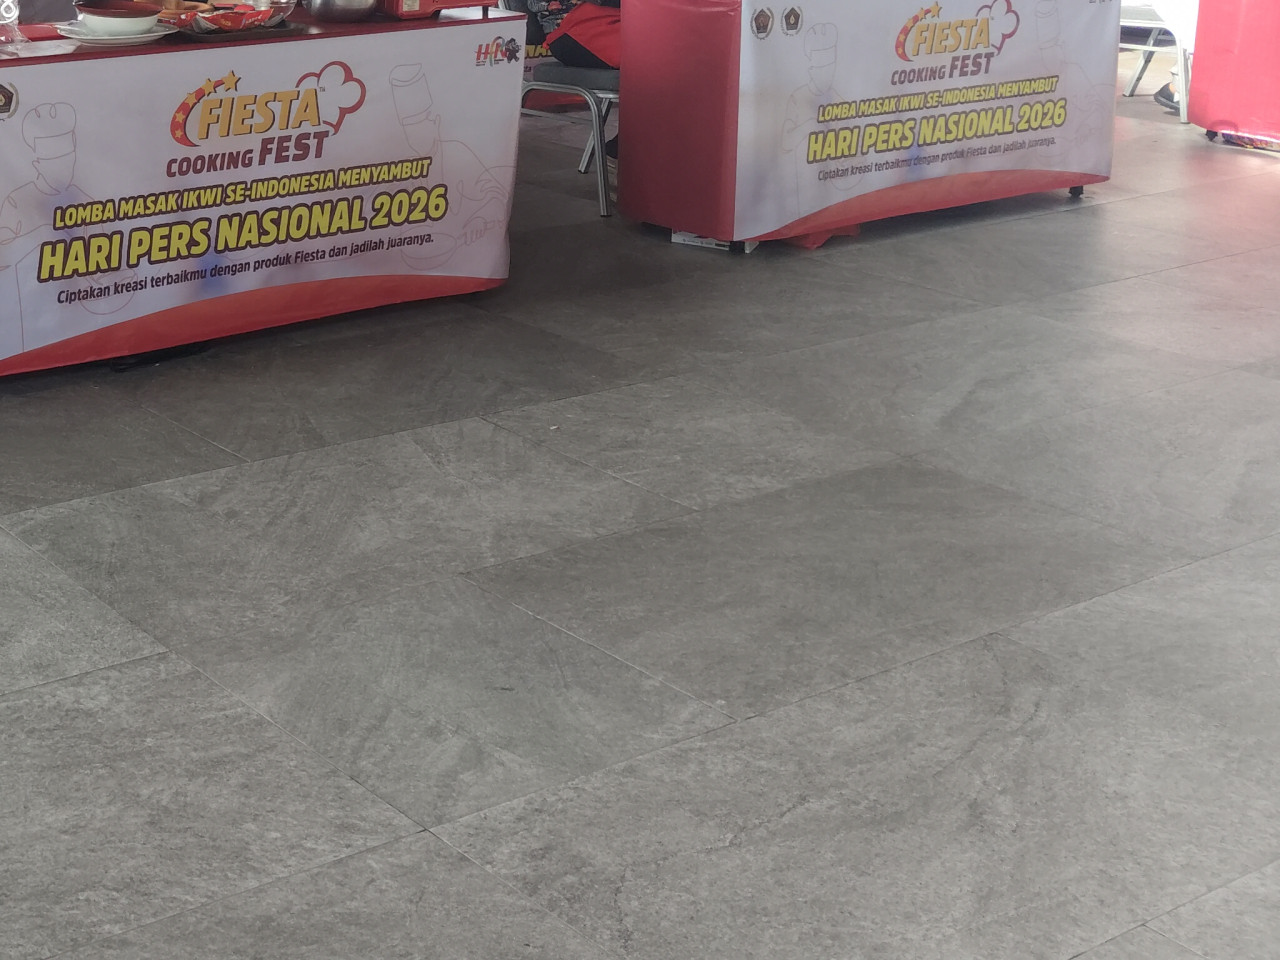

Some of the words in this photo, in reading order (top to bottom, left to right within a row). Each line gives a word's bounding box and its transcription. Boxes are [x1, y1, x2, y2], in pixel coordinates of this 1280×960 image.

[911, 18, 990, 57] FIESTA
[891, 65, 945, 85] COOKING
[949, 52, 995, 78] FEST
[198, 87, 321, 141] FIESTA
[817, 102, 856, 123] LOMBA
[857, 97, 898, 118] MASAK
[899, 93, 926, 112] IKWI
[926, 83, 996, 109] SE-INDONESIA
[996, 75, 1059, 98] MENYAMBUT
[166, 148, 253, 178] COOKING
[258, 130, 330, 166] FEST
[806, 123, 858, 164] HARI
[860, 117, 916, 156] PERS
[918, 105, 1015, 147] NASIONAL
[1015, 98, 1068, 133] 2026
[818, 165, 850, 181] Ciptakan
[850, 161, 873, 175] kreasi
[874, 156, 912, 172] terbaikmu
[913, 152, 940, 168] dengan
[940, 149, 966, 164] produk
[966, 145, 987, 158] Fiesta
[988, 143, 1002, 155] dan
[1002, 138, 1027, 153] jadilah
[1027, 136, 1057, 151] juaranya.
[53, 198, 117, 231] LOMBA
[117, 189, 181, 220] MASAK
[182, 183, 223, 209] IKWI
[224, 169, 337, 205] SE-INDONESIA
[336, 156, 432, 188] MENYAMBUT
[37, 231, 124, 283] HARI
[125, 218, 213, 269] PERS
[215, 194, 370, 253] NASIONAL
[368, 183, 449, 229] 2026
[57, 285, 110, 305] Ciptakan
[113, 275, 148, 296] kreasi
[150, 266, 207, 289] terbaikmu
[209, 259, 251, 279] dengan
[253, 253, 292, 274] produk
[294, 247, 326, 265] Fiesta
[329, 243, 347, 258] dan
[348, 237, 385, 257] jadilah
[385, 231, 434, 251] juaranya.
